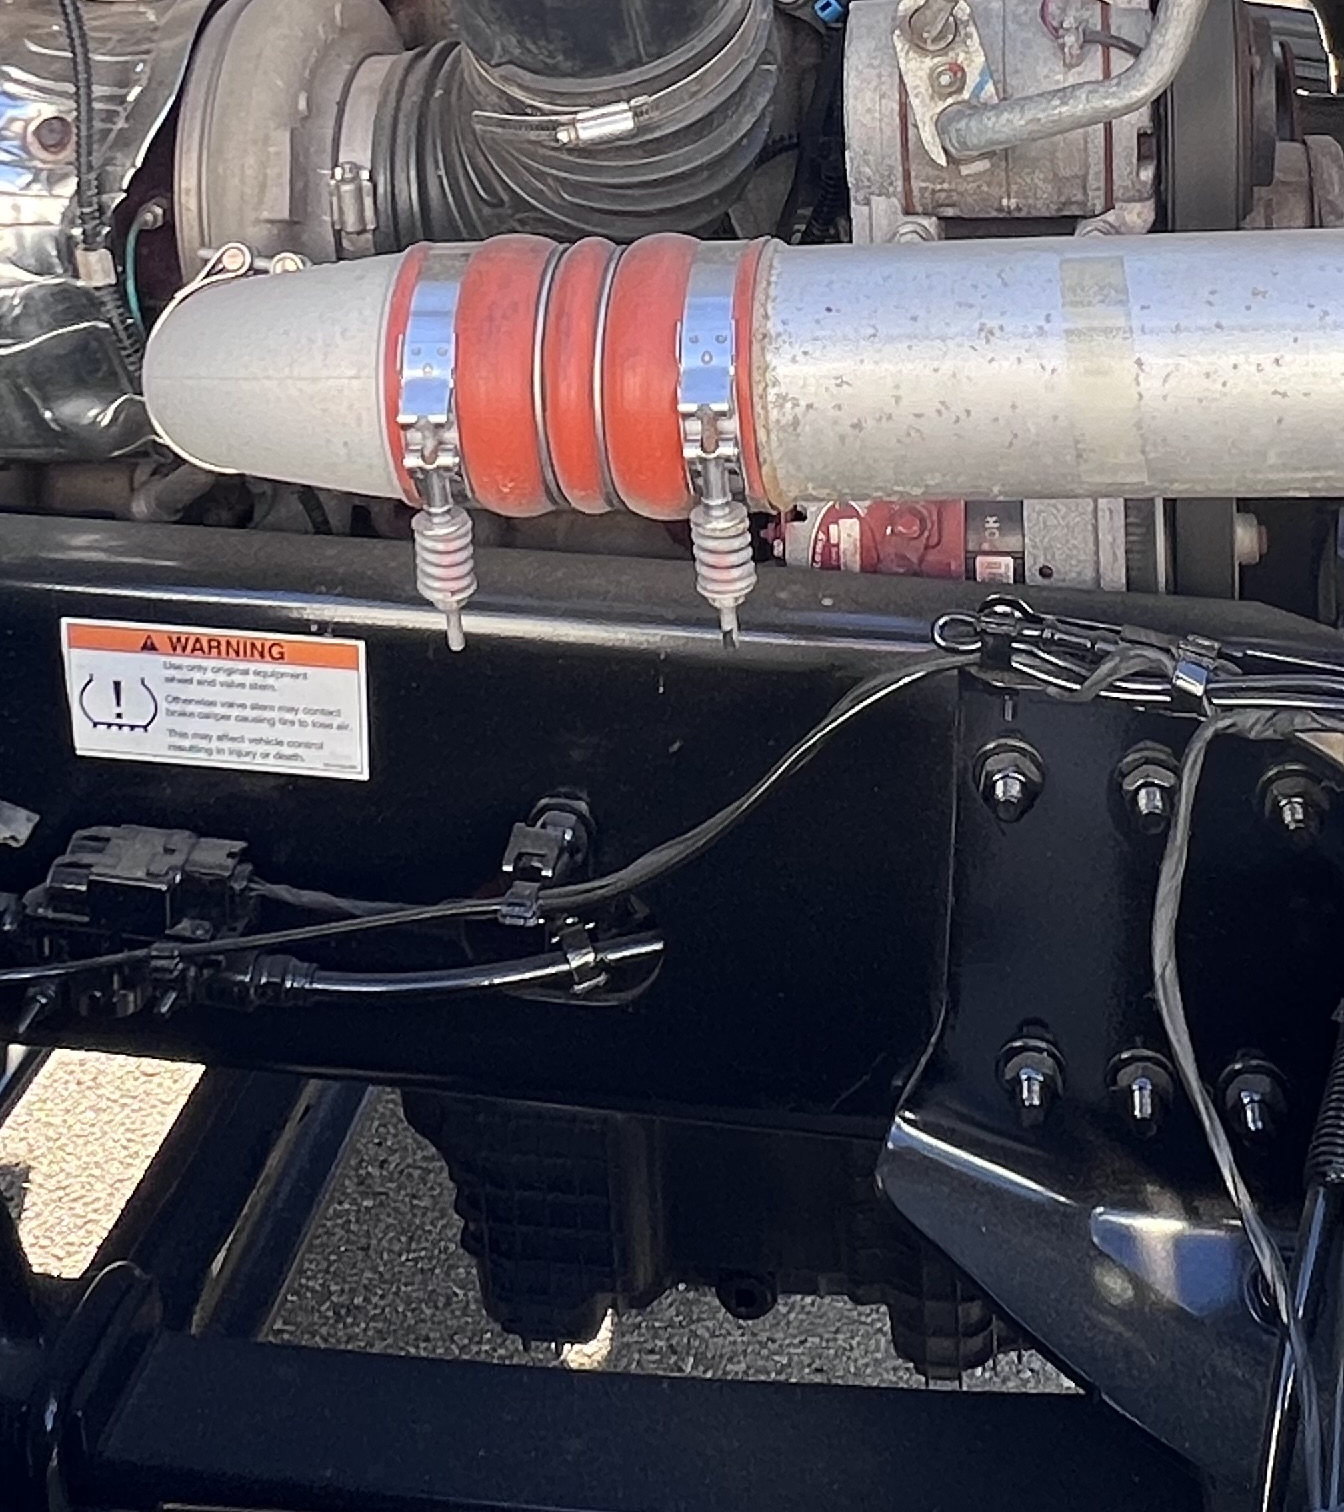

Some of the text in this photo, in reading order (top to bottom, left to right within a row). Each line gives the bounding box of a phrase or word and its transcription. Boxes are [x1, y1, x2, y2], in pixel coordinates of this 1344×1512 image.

[167, 635, 285, 661] WARNING
[163, 661, 184, 670] Use
[211, 665, 250, 677] original
[252, 668, 308, 680] equipment
[197, 678, 217, 687] and
[277, 705, 300, 716] may
[302, 706, 342, 717] contact
[234, 714, 276, 728] causing
[298, 718, 309, 728] to
[191, 732, 214, 744] may
[247, 736, 285, 748] vehicle
[286, 740, 324, 750] control
[167, 744, 214, 757] resulting
[215, 746, 226, 756] in
[227, 747, 258, 761] injury
